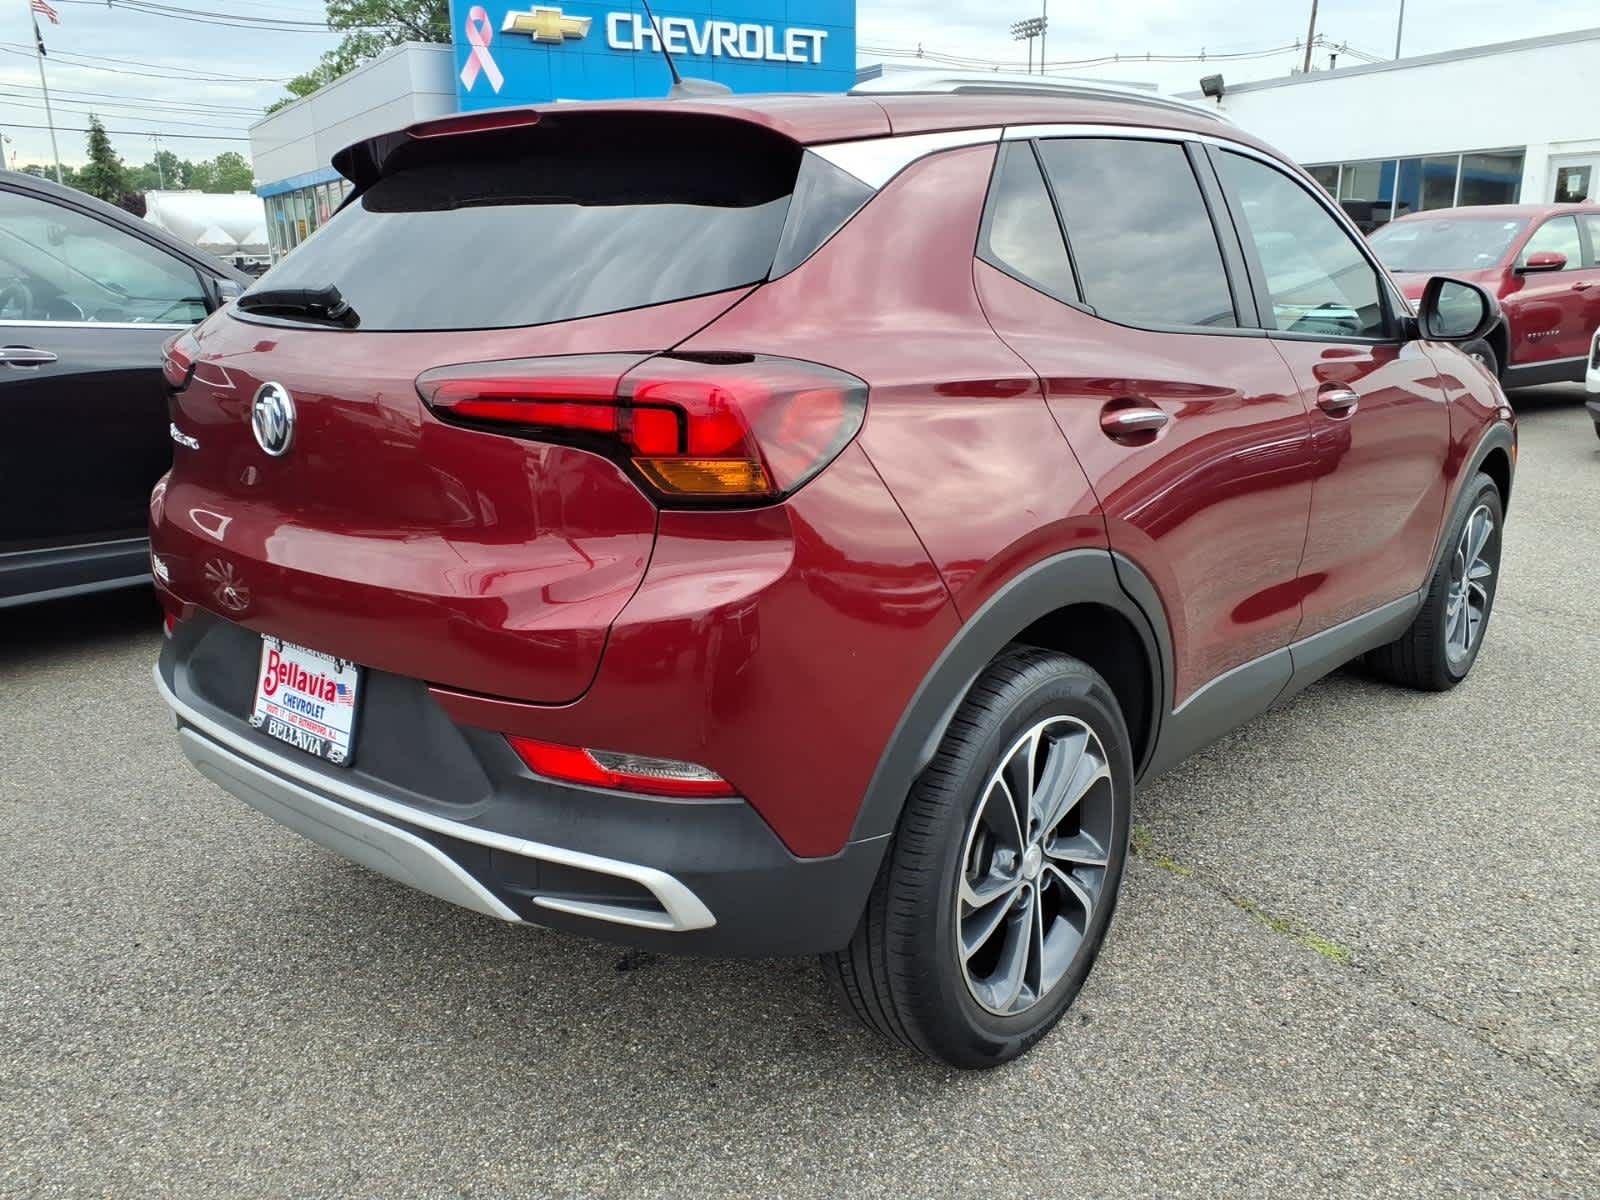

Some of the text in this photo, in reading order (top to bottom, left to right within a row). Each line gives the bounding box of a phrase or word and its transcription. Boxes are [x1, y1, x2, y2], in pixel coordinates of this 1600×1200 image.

[607, 11, 829, 65] CHEVROLET
[263, 649, 337, 702] Bellavia
[283, 693, 325, 720] CHEVROLET
[267, 719, 322, 756] BELLAVIA
